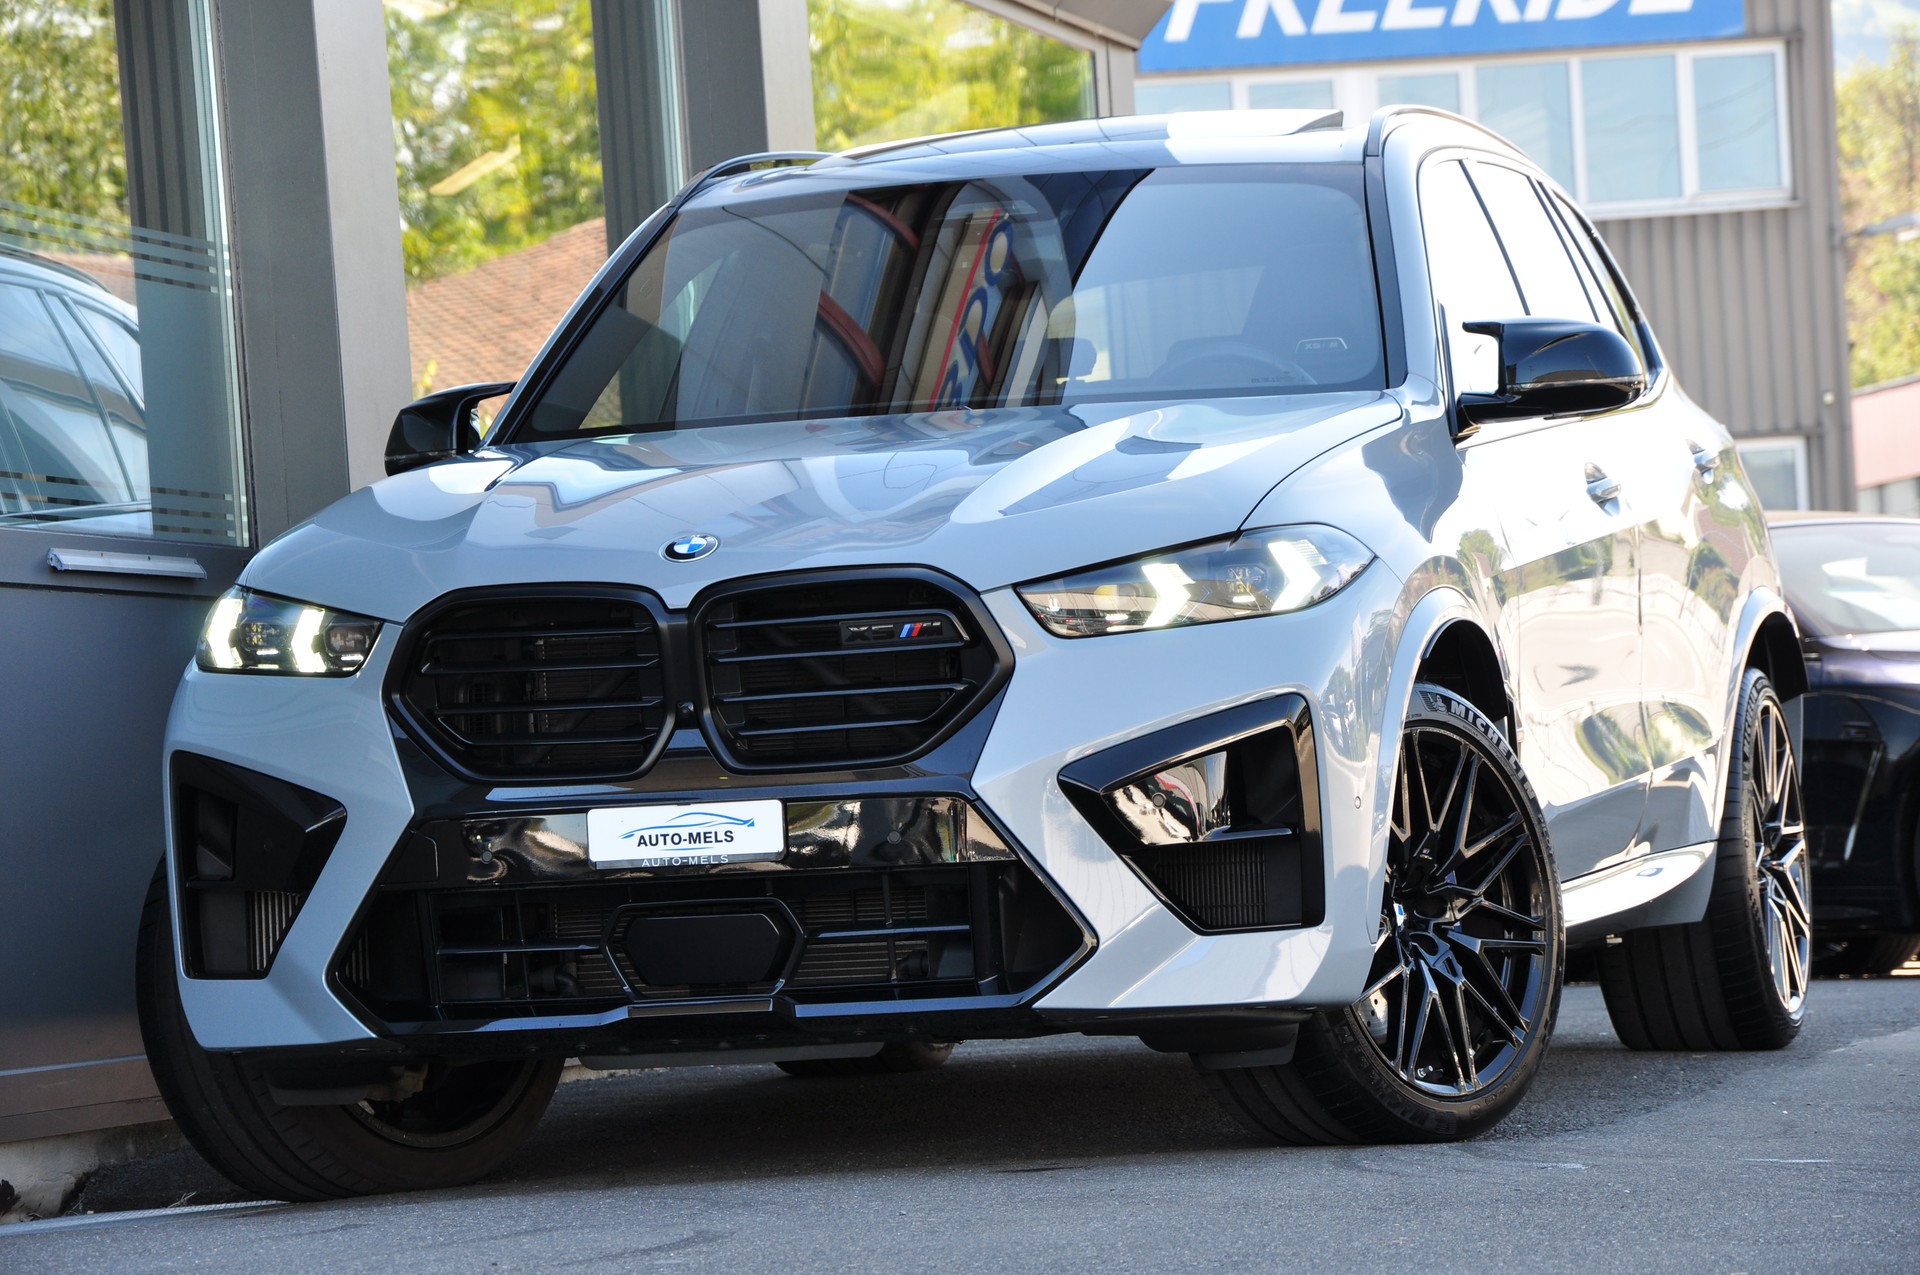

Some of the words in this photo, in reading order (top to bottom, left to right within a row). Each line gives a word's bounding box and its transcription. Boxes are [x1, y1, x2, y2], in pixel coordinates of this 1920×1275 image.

[1450, 700, 1536, 799] MICHELIN
[637, 830, 734, 847] AUTO-MELS
[641, 854, 729, 867] AUTO-MELS
